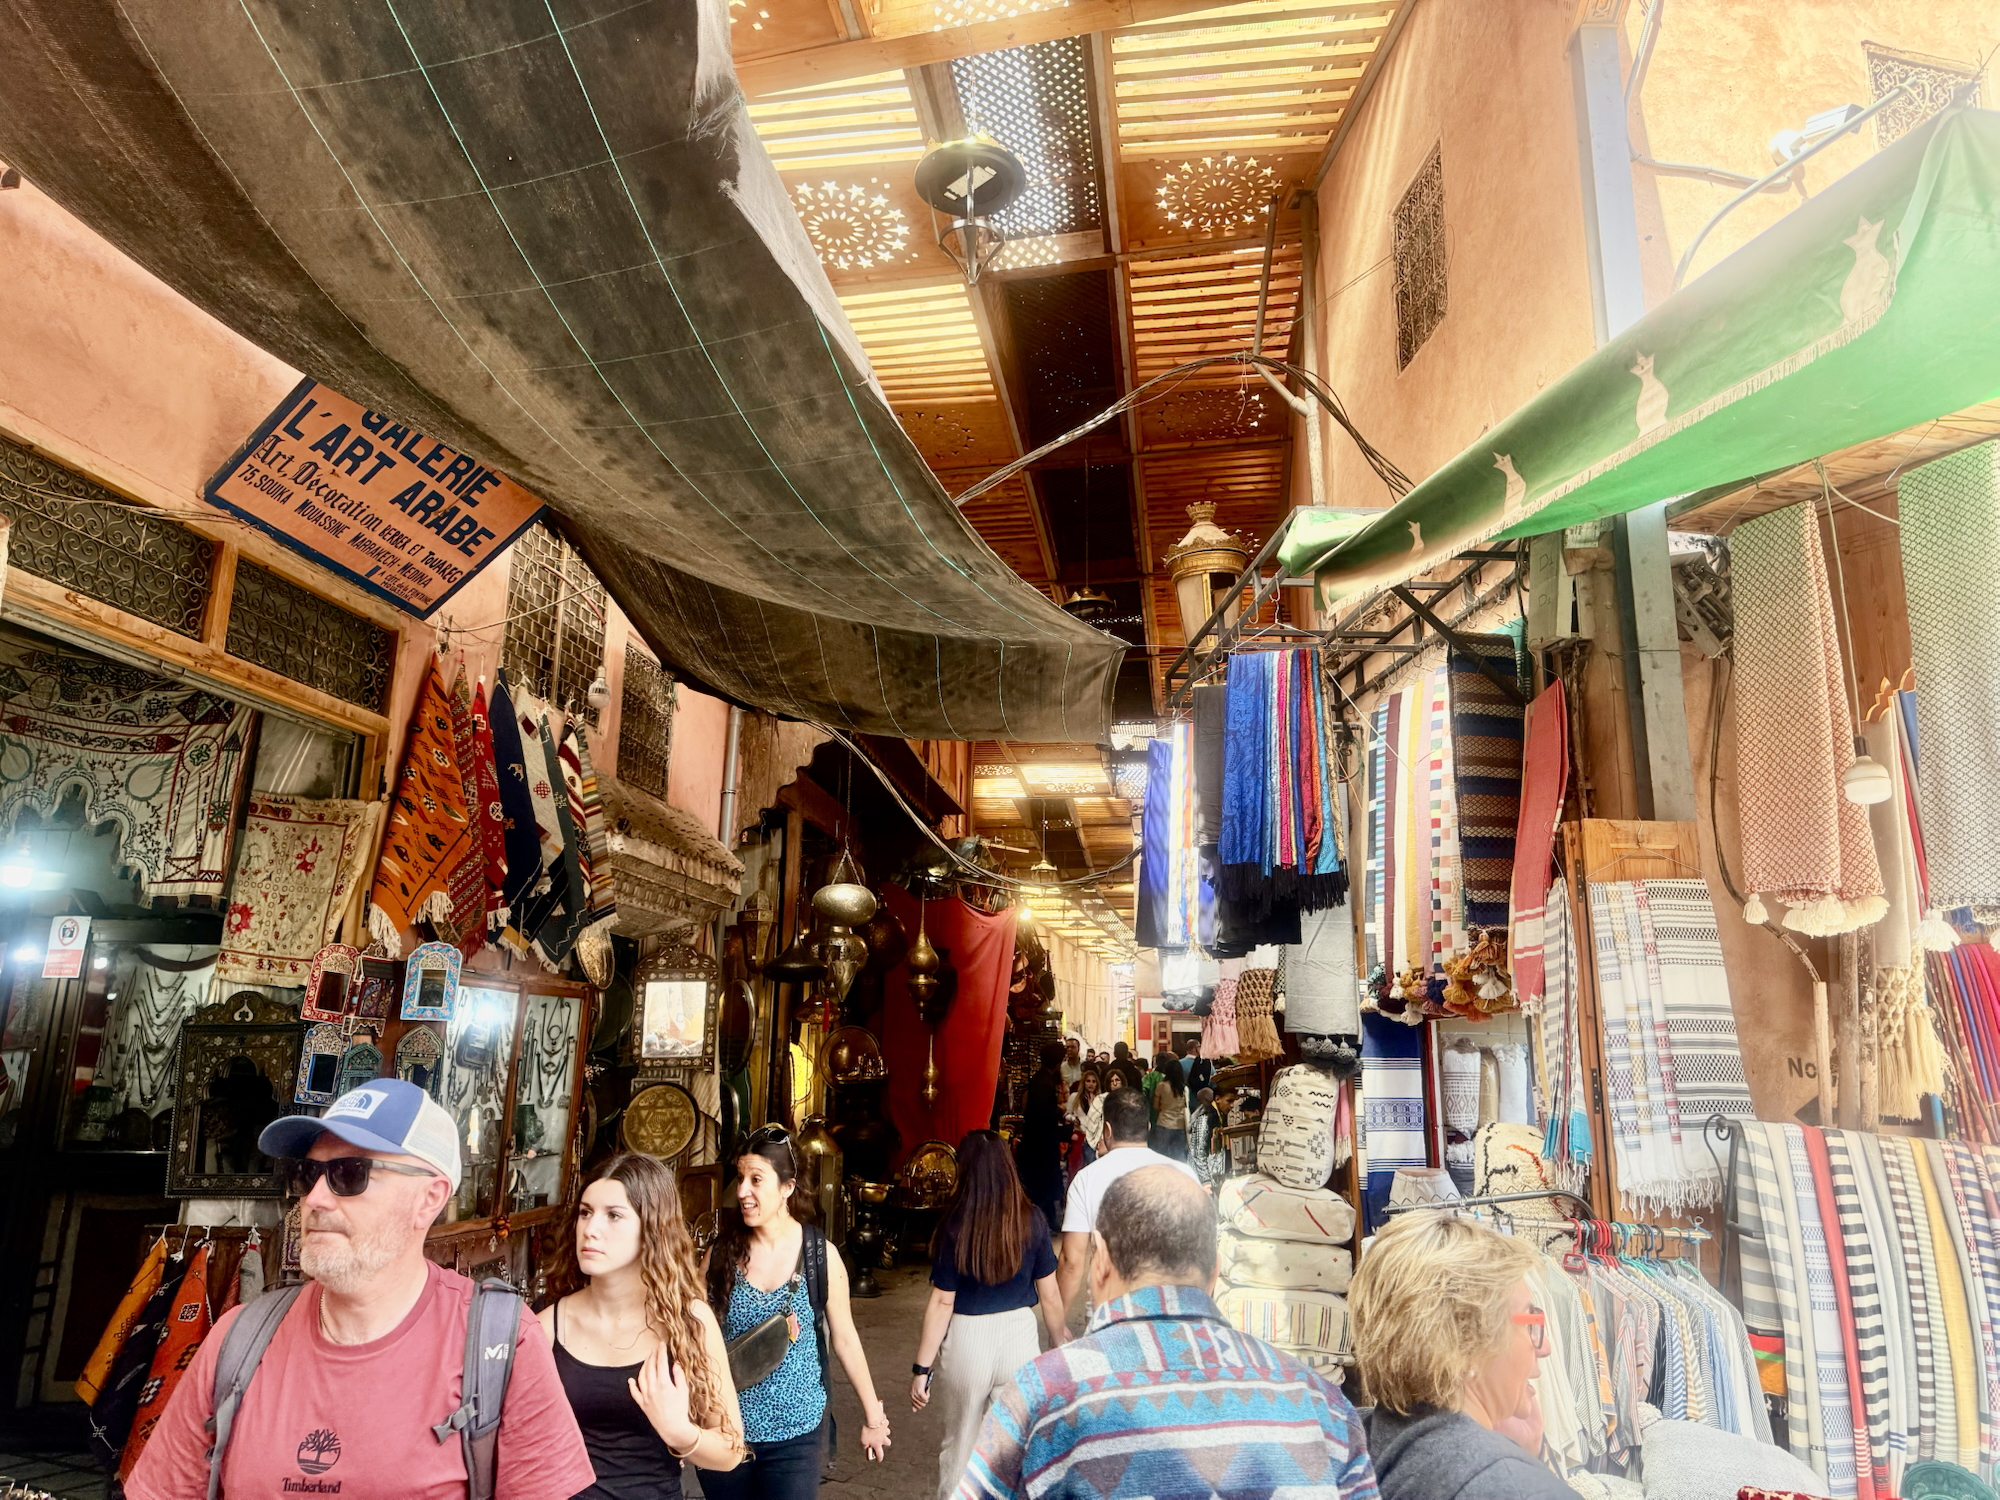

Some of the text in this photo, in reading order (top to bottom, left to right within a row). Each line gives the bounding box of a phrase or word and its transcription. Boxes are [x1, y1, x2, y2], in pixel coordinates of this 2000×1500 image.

[252, 434, 287, 478] Art,
[288, 461, 383, 532] Décoration
[407, 543, 425, 557] ET
[361, 409, 502, 508] GALERIE
[293, 498, 350, 539] MOUASSINE
[389, 480, 497, 558] ARABE
[282, 1477, 342, 1494] Timberland
